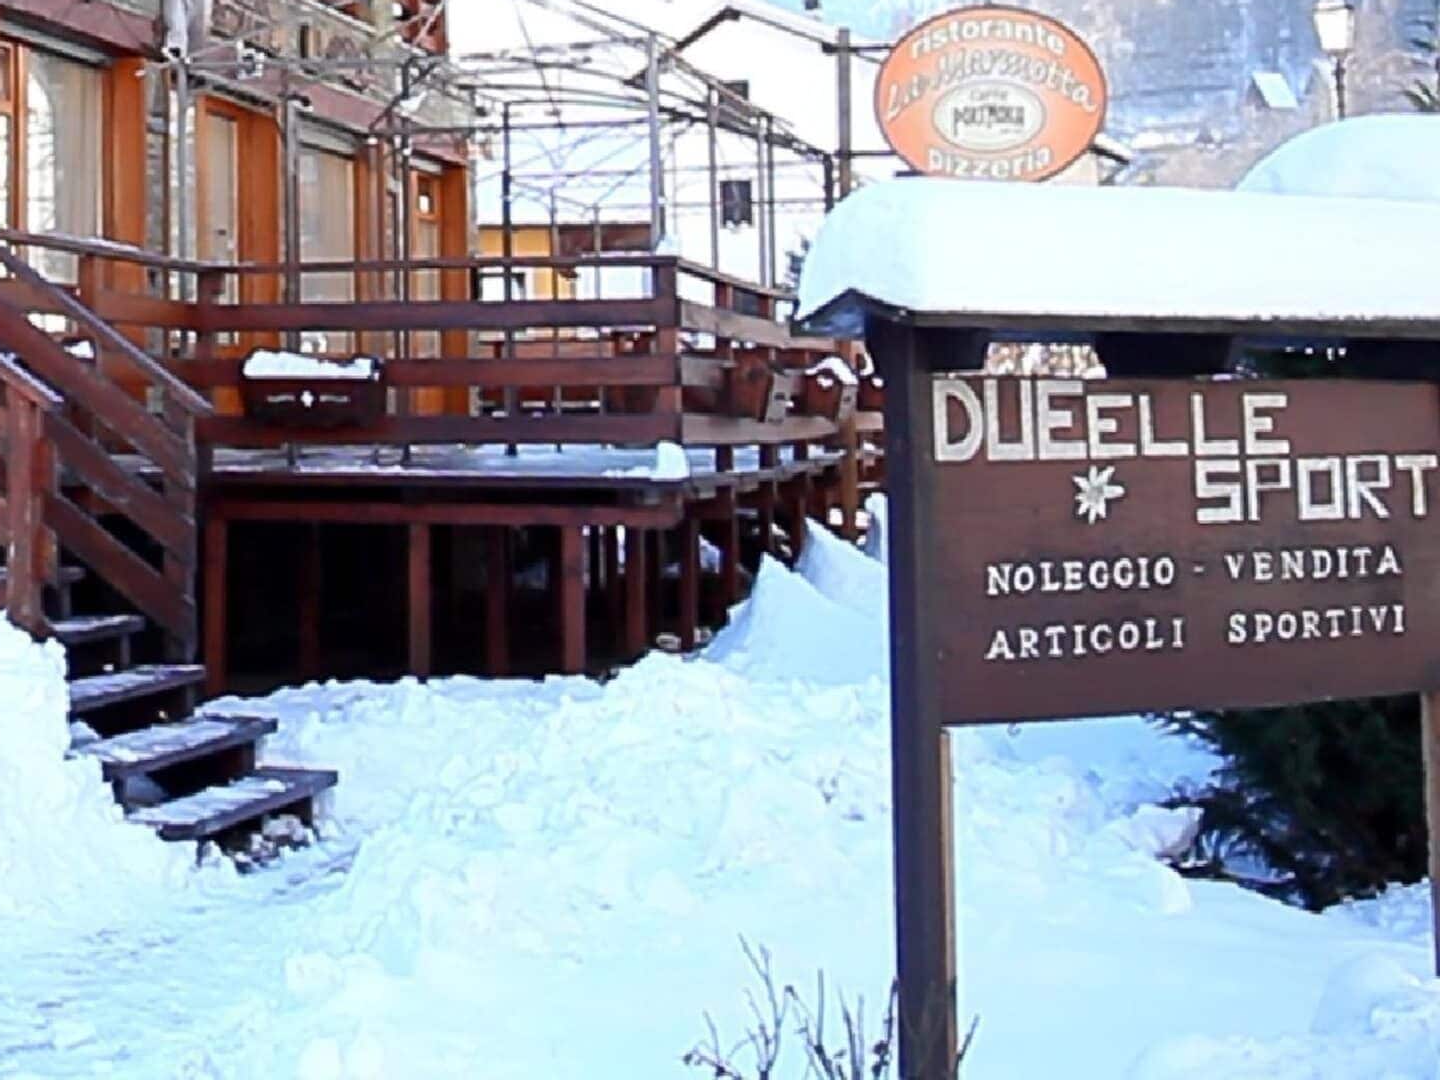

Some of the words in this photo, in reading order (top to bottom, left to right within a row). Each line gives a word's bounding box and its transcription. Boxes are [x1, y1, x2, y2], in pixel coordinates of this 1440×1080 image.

[913, 19, 1065, 58] ristorante
[934, 48, 1097, 113] Marmotta
[928, 147, 1052, 178] pizzeria
[933, 379, 1291, 462] DUEELLE
[1195, 453, 1439, 524] SPORT
[986, 556, 1176, 597] NOLEGGIO
[1224, 545, 1403, 581] VENDITA
[983, 618, 1187, 661] ARTICOLI
[1227, 603, 1407, 645] SPORTIVI
